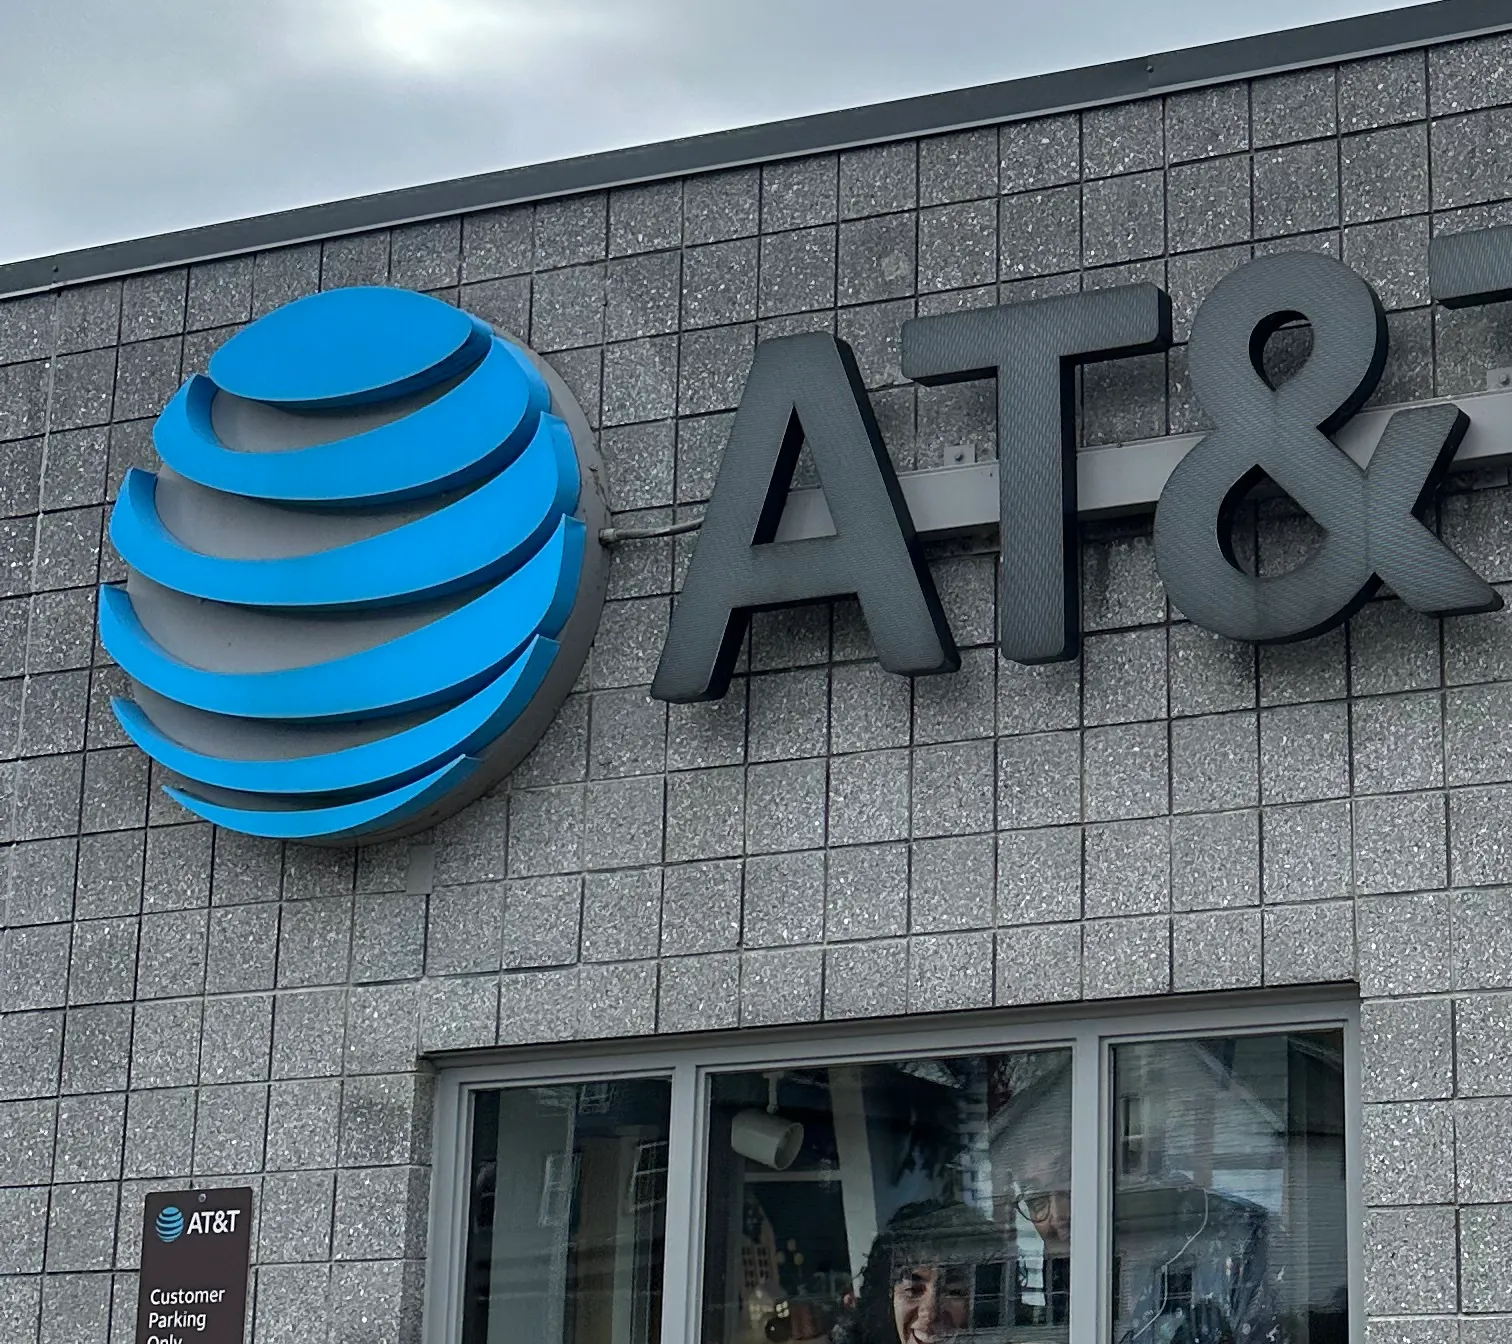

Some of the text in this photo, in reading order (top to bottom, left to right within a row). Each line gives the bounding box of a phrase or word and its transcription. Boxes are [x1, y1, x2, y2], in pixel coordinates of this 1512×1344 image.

[186, 1209, 241, 1235] AT&T
[150, 1288, 226, 1306] Customer
[148, 1310, 207, 1332] Parking
